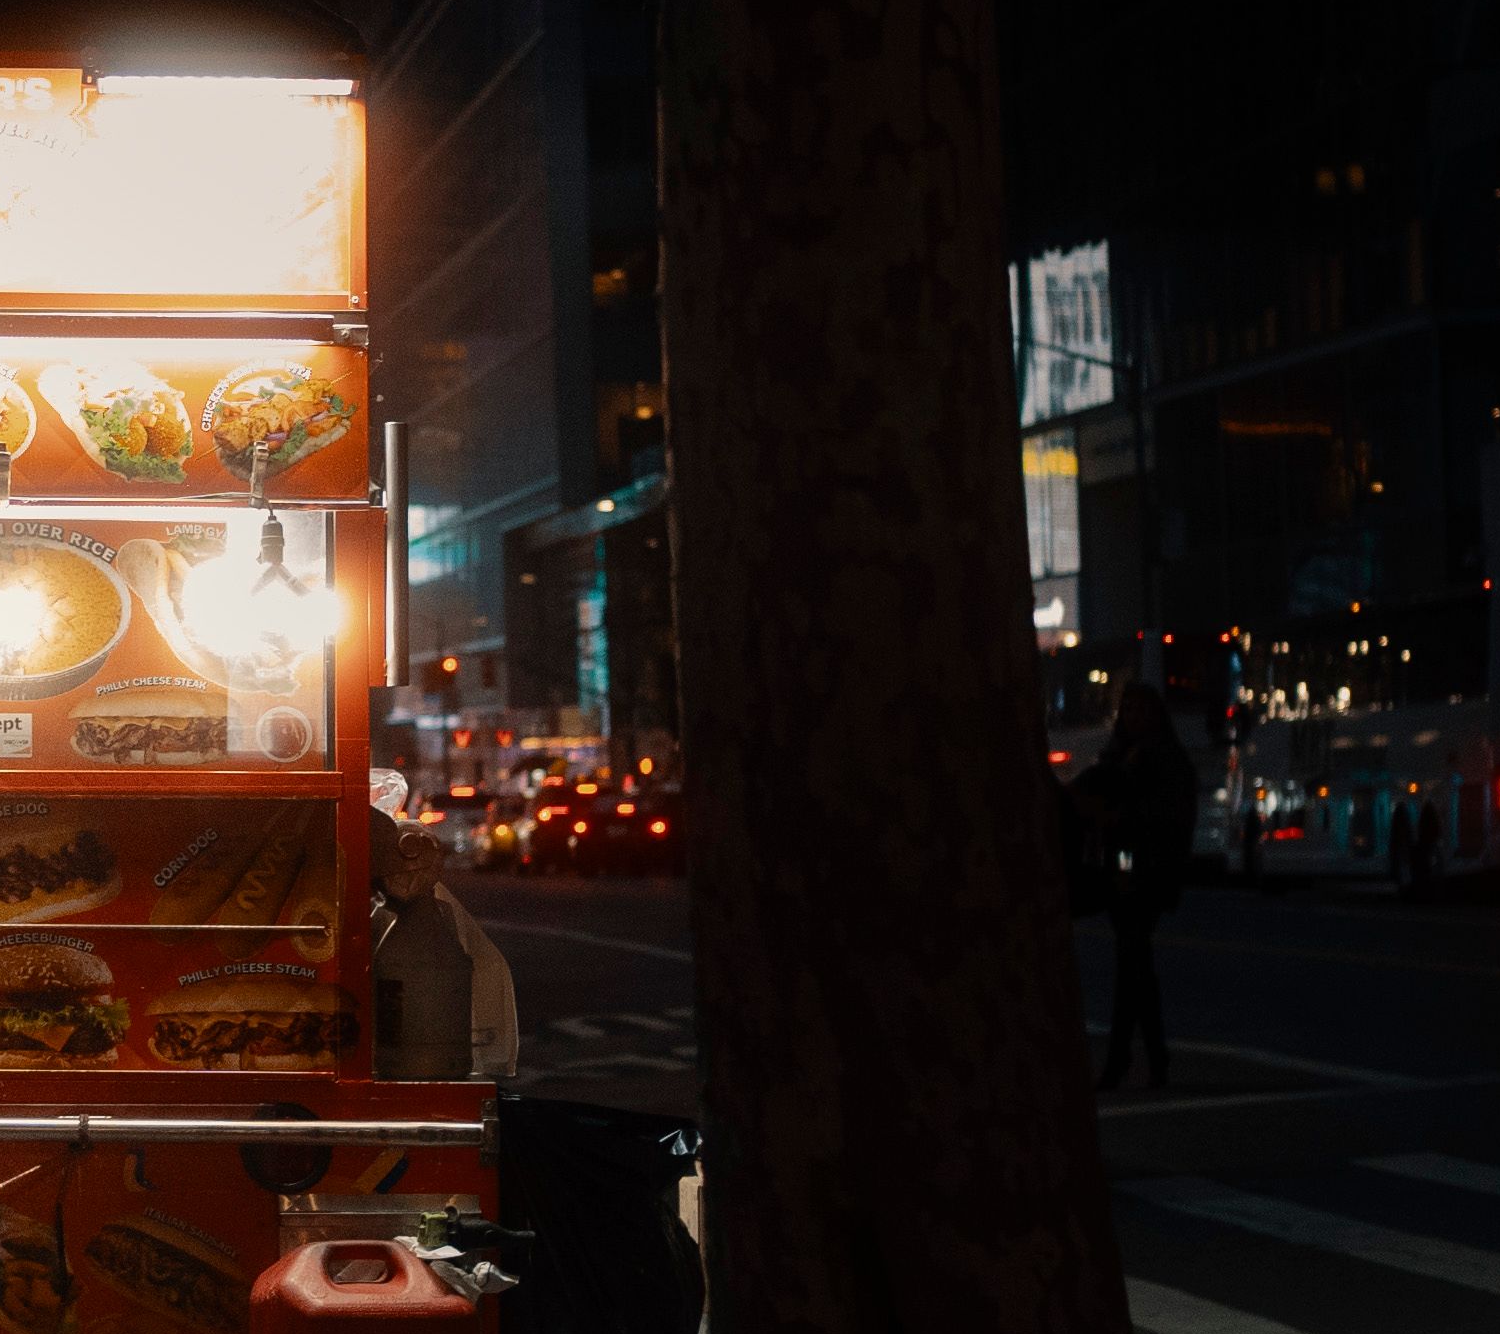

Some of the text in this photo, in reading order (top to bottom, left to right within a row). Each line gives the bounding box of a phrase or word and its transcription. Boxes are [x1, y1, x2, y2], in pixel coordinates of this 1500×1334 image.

[166, 524, 204, 536] LAMB
[11, 521, 63, 541] OVER
[69, 530, 116, 562] RICE
[95, 676, 207, 695] PHILLY CHEESE STEAK
[15, 802, 49, 815] DOG
[153, 828, 218, 888] CORN DOG
[178, 963, 317, 986] PHILLY CHEESE STEAK
